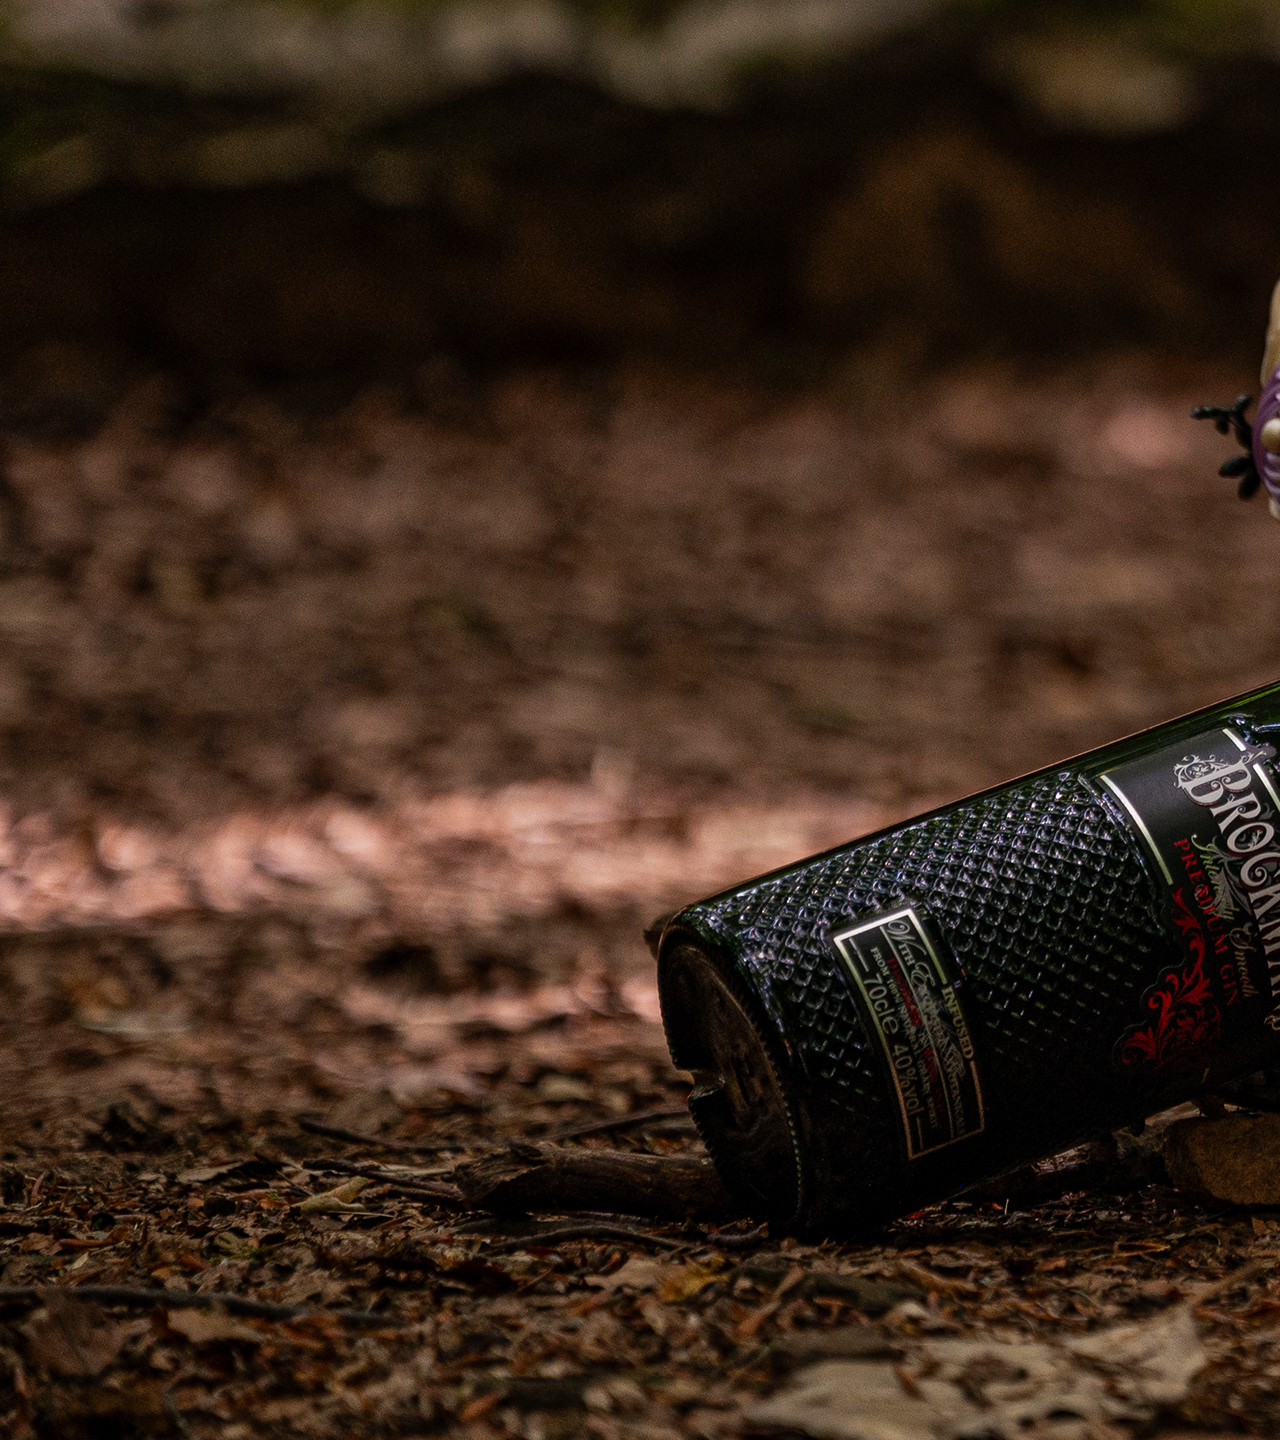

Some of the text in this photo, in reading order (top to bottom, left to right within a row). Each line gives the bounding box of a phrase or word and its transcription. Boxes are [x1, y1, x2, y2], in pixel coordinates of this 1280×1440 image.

[886, 918, 927, 966] WITH
[1173, 837, 1242, 1006] PREMIUM GIN
[1189, 832, 1260, 999] Intenly Smooth
[869, 946, 890, 976] FROM
[939, 984, 975, 1061] INFUSED
